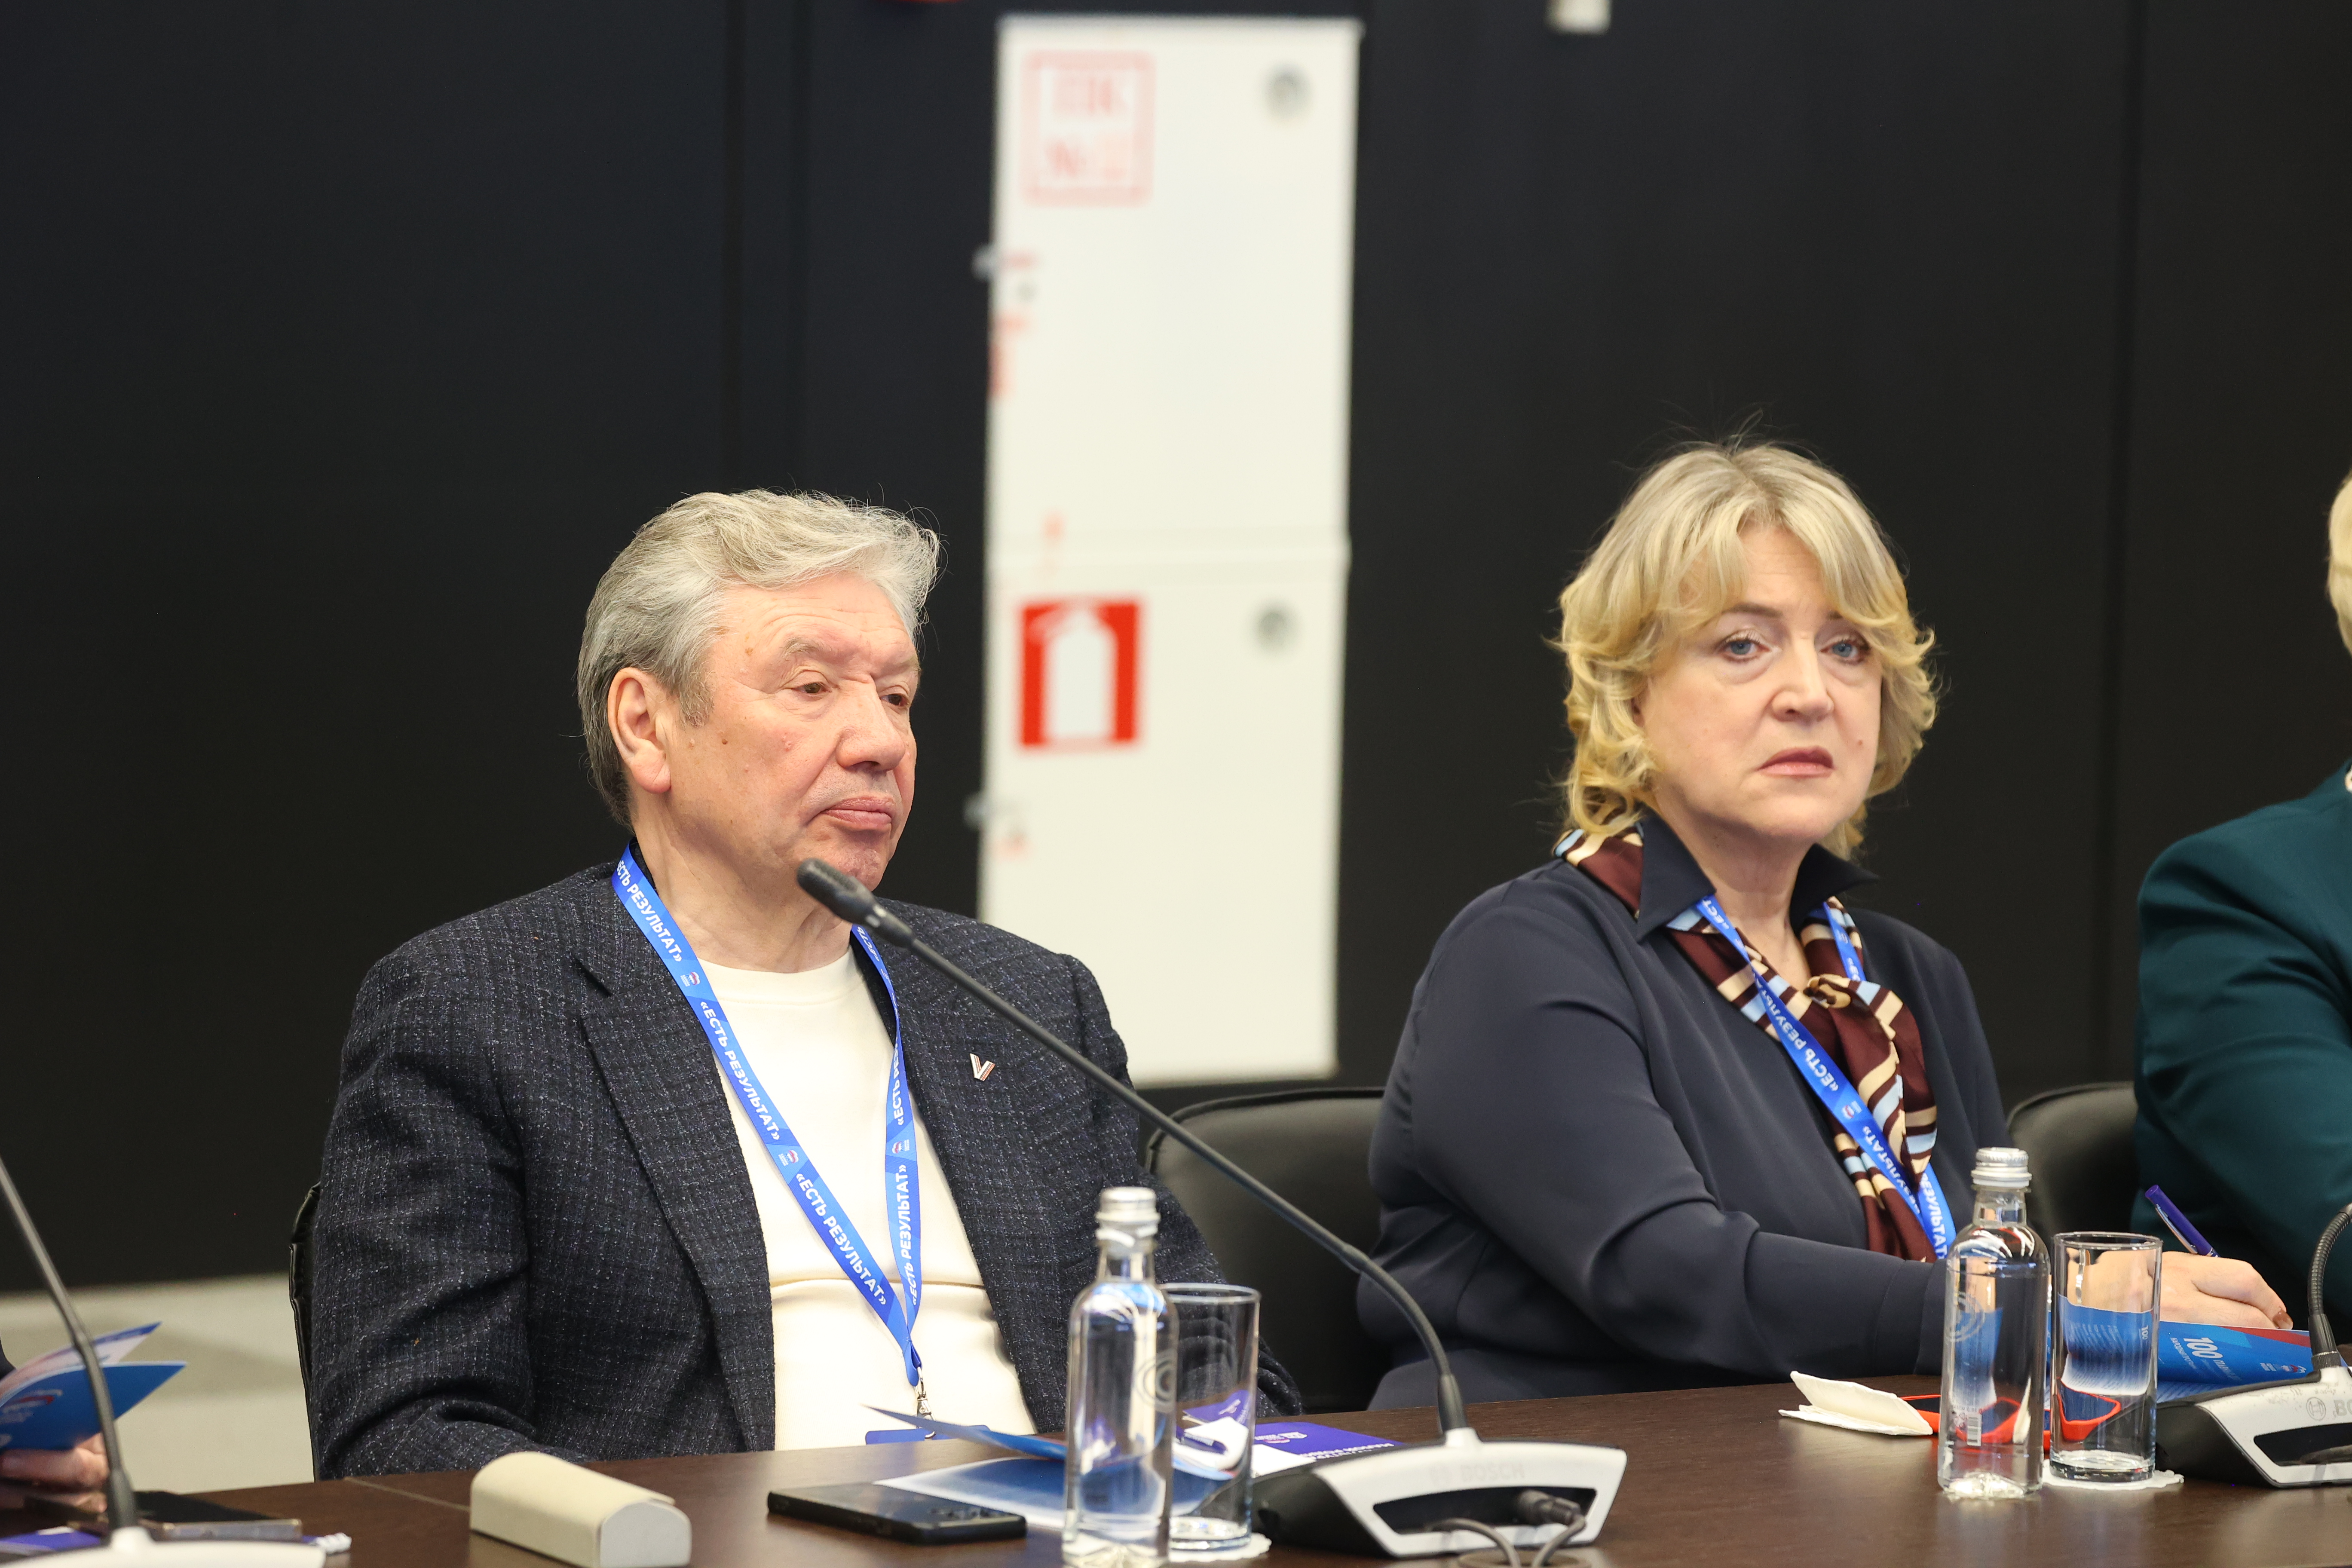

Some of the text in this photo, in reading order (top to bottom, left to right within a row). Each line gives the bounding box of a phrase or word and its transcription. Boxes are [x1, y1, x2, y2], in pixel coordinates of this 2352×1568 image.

[617, 860, 683, 962] ЕСТЬ РЕЗУЛЬТАТ»
[1702, 899, 1730, 930] «ЕСТ
[701, 1001, 780, 1140] «ЕСТЬ РЕЗУЛЬТАТ»
[892, 1079, 904, 1126] «ЕСТЬ
[1805, 1048, 1839, 1092] «ЕСТЬ
[796, 1173, 887, 1305] «ЕСТЬ РЕЗУЛЬТАТ»
[895, 1164, 917, 1306] «ЕСТЬ РЕЗУЛЬТАТ»
[2184, 1337, 2223, 1359] 100
